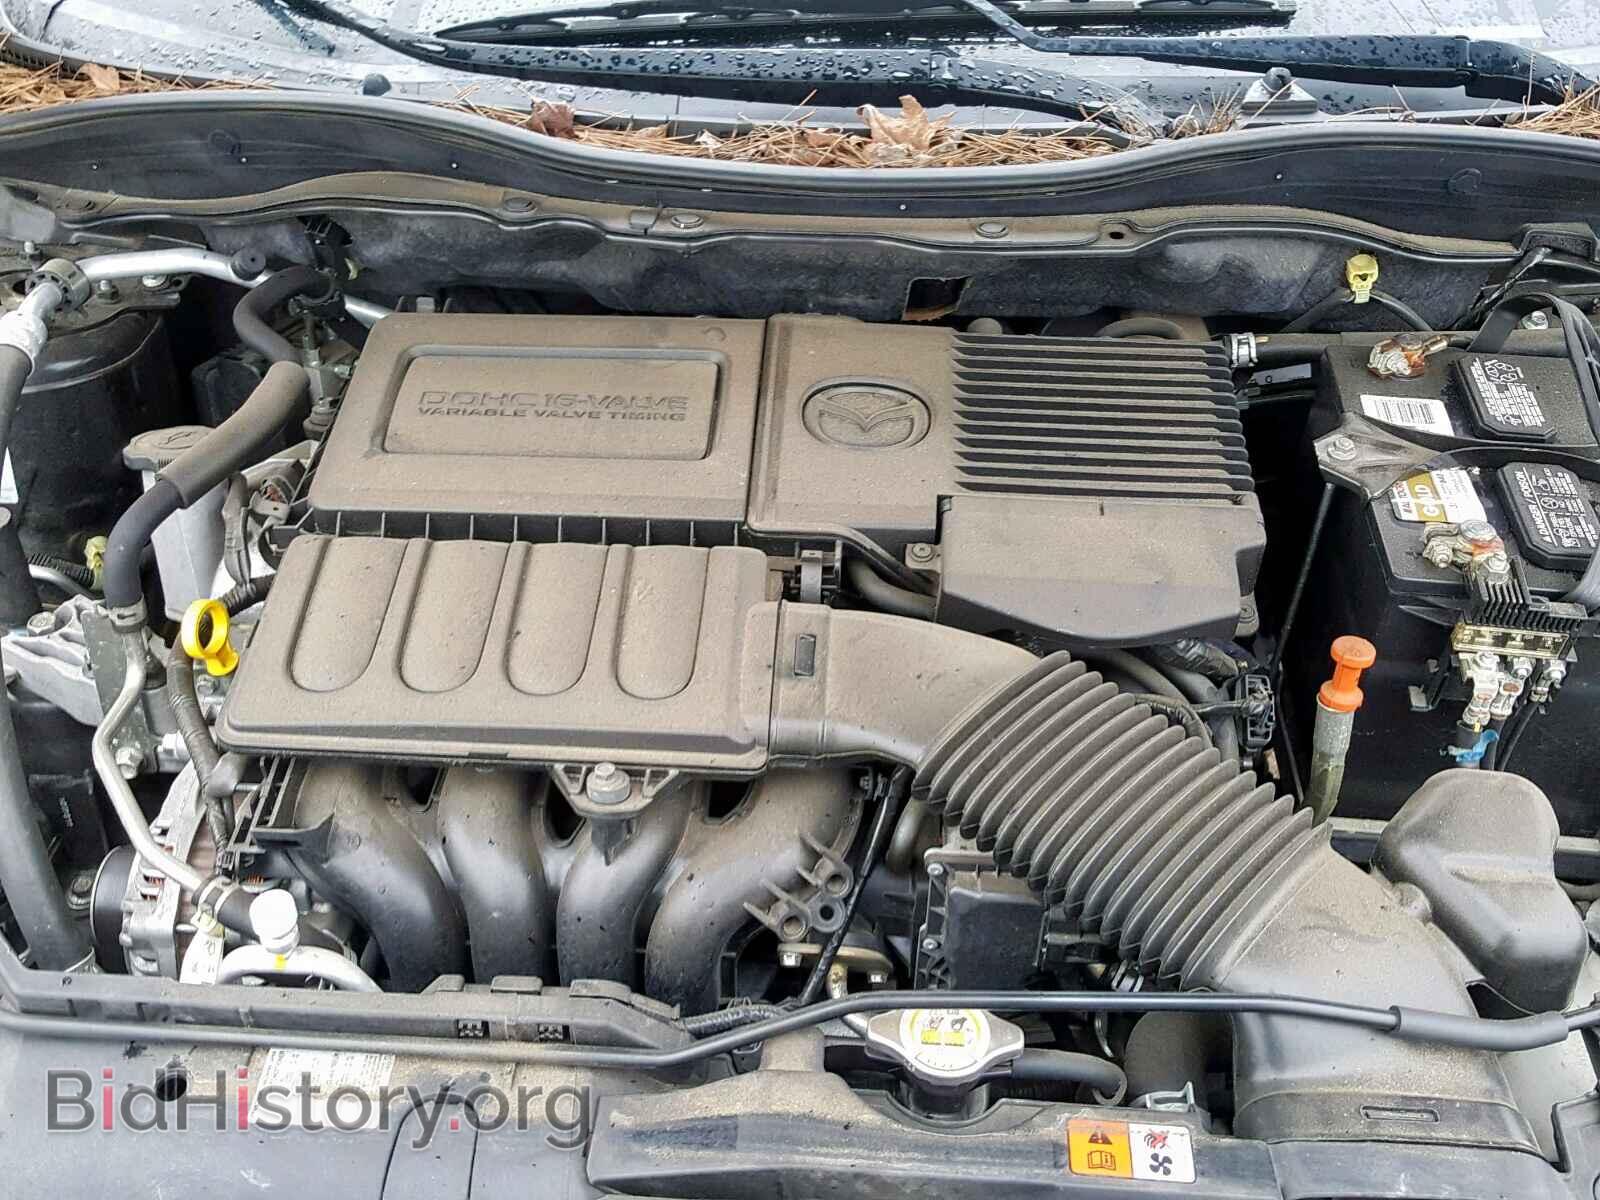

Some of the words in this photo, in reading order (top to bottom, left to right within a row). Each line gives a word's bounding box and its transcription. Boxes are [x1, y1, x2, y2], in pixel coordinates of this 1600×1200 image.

[418, 391, 538, 406] DOHC
[544, 393, 689, 410] 16-VALVE
[417, 407, 526, 418] VARIABLE
[533, 409, 600, 420] VALVE
[608, 411, 687, 422] TIMING
[1514, 471, 1533, 498] POISON
[1528, 505, 1549, 536] DANGER
